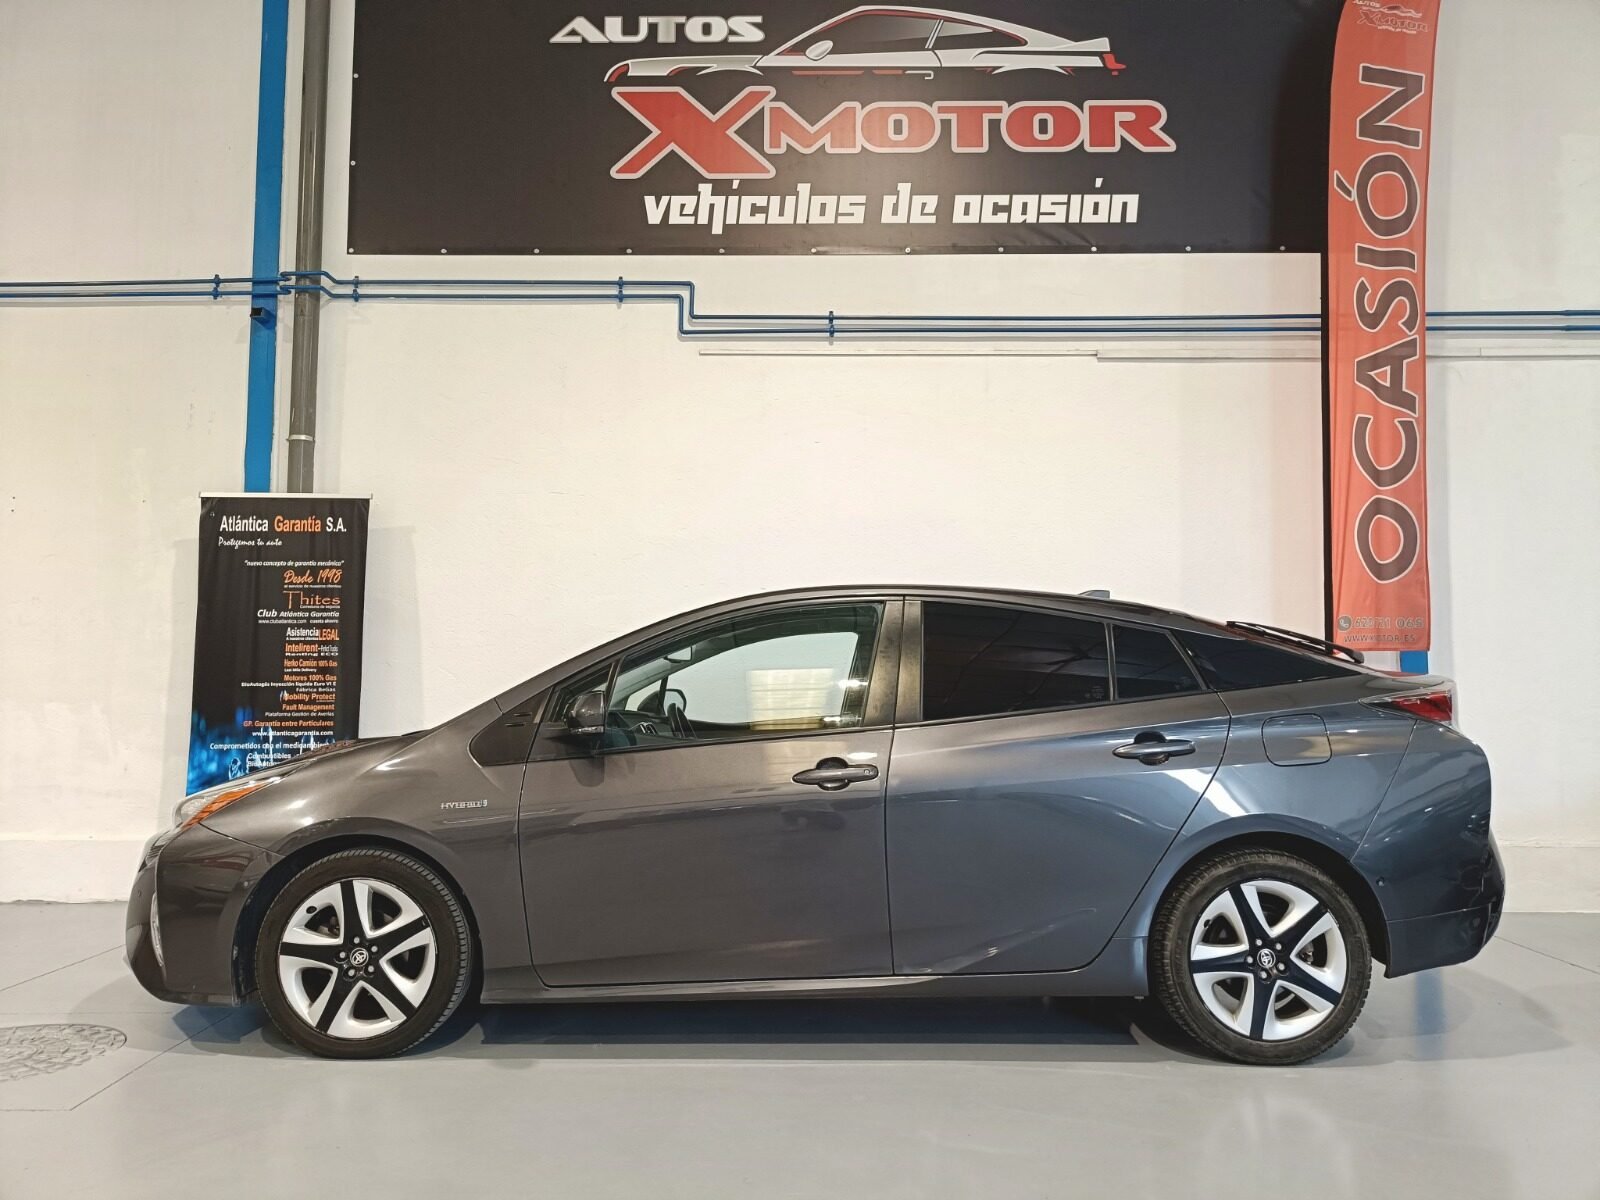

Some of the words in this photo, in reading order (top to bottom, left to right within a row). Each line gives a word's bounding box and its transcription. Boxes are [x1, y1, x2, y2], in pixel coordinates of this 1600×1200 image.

[549, 15, 766, 44] AUTOS
[609, 85, 1176, 179] XMOTOR
[643, 179, 867, 235] vehículos
[880, 182, 939, 223] de
[952, 177, 1139, 223] ocasión
[1334, 63, 1426, 584] OCASIÓN
[219, 515, 268, 532] Atlántica
[274, 515, 321, 532] Garantía
[325, 516, 347, 532] S.A.
[218, 536, 255, 549] Protegemos
[283, 569, 314, 584] Desde
[317, 568, 342, 584] 1998
[283, 591, 341, 609] Thites
[257, 608, 278, 618] Club
[279, 610, 309, 618] Atlántica
[310, 610, 340, 618] Garantía
[209, 742, 261, 751] Comprometidos
